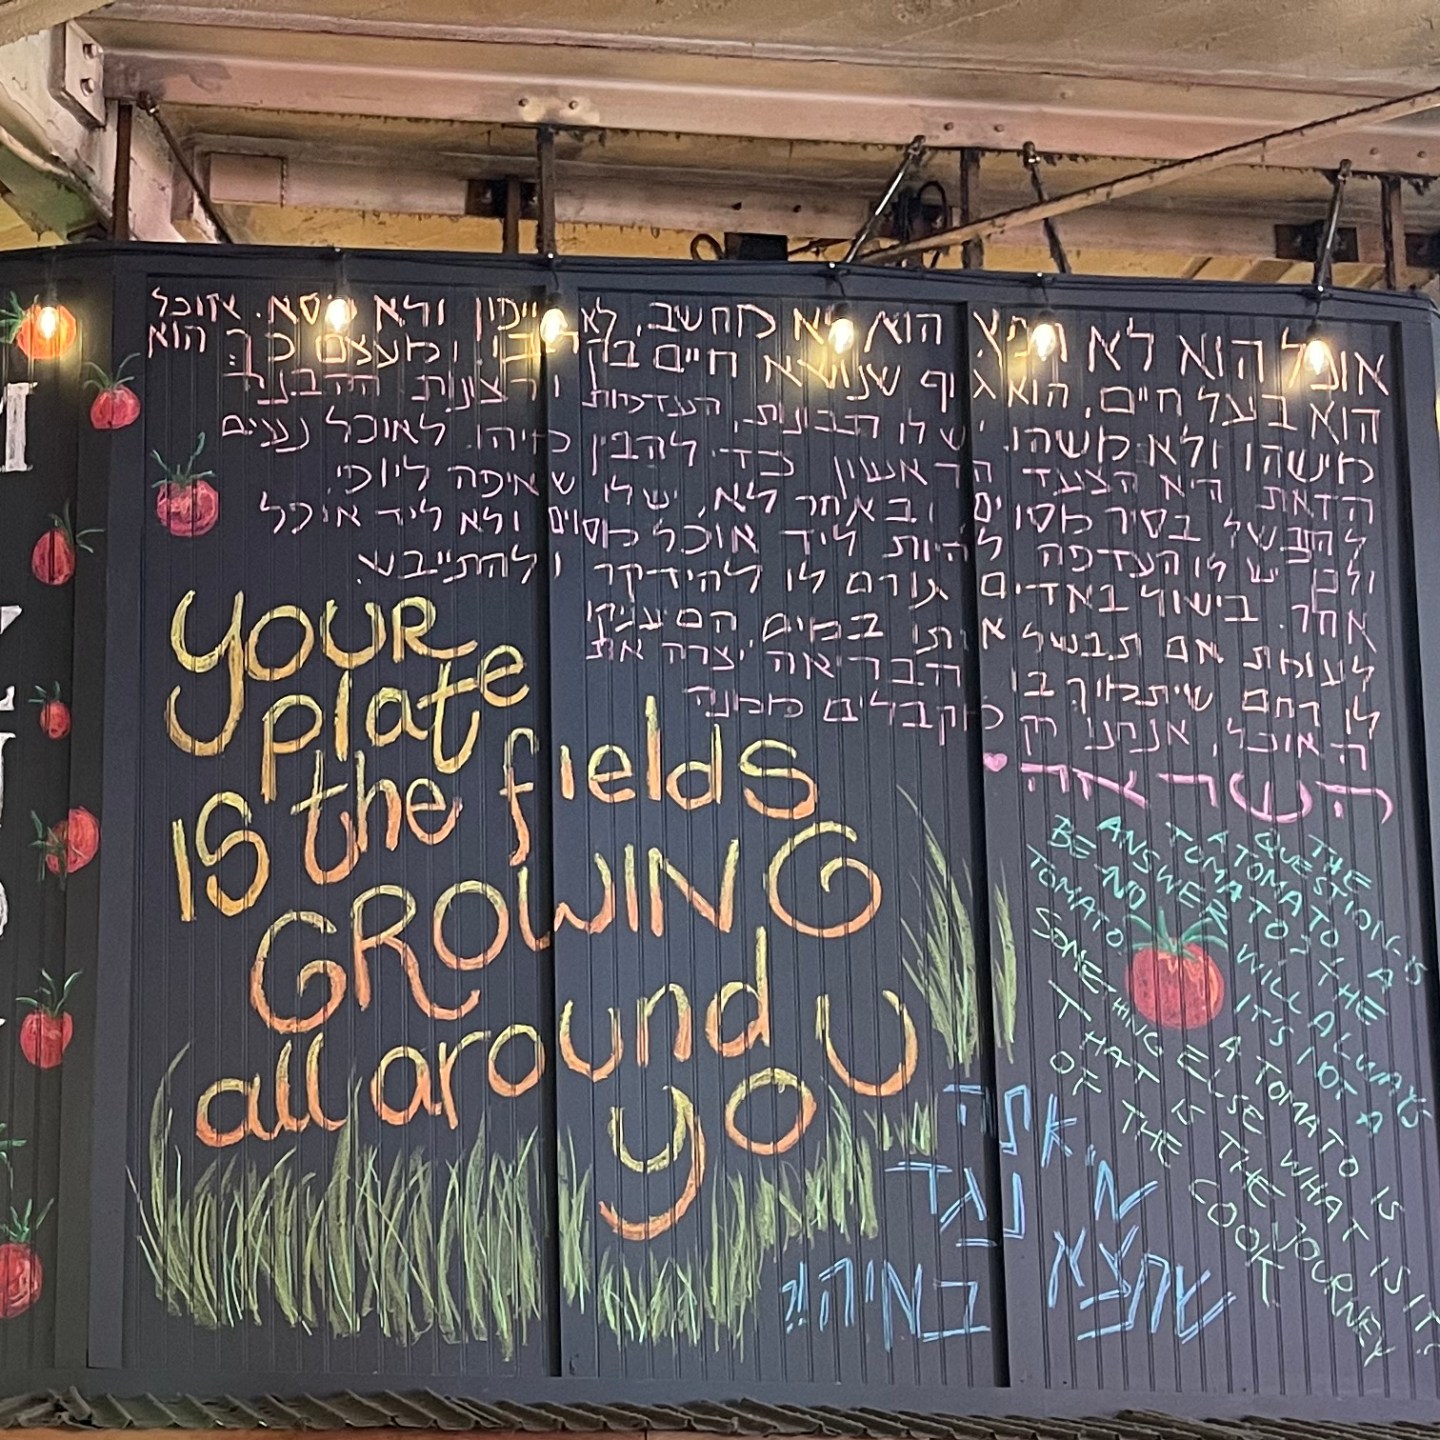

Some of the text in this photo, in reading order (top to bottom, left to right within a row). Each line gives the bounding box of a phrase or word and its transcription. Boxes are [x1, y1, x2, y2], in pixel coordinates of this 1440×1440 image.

[171, 694, 821, 925] IS the fields
[261, 643, 530, 806] plate
[248, 818, 885, 1038] GROWING
[1097, 815, 1433, 1129] ANSWER WILL ALWAYS
[1207, 830, 1229, 853] A
[1234, 844, 1341, 950] TOMATO
[1254, 828, 1401, 951] QUESTION
[1308, 834, 1373, 890] THE
[194, 925, 773, 1150] all around
[1048, 814, 1097, 859] BE
[1094, 863, 1147, 911] NO
[1234, 993, 1295, 1047] IT'S
[1355, 1109, 1384, 1137] A
[1317, 956, 1388, 1026] THE
[1032, 907, 1412, 1294] SOMETHING ELSE WHAT IS
[1048, 980, 1160, 1085] THAT
[1219, 1131, 1287, 1208] THE
[1272, 1217, 1396, 1367] JOURNEY
[1049, 1050, 1285, 1309] OF THE COOK
[1219, 1036, 1242, 1062] A
[1254, 1056, 1361, 1178] TOMATO
[1371, 1186, 1406, 1221] IS
